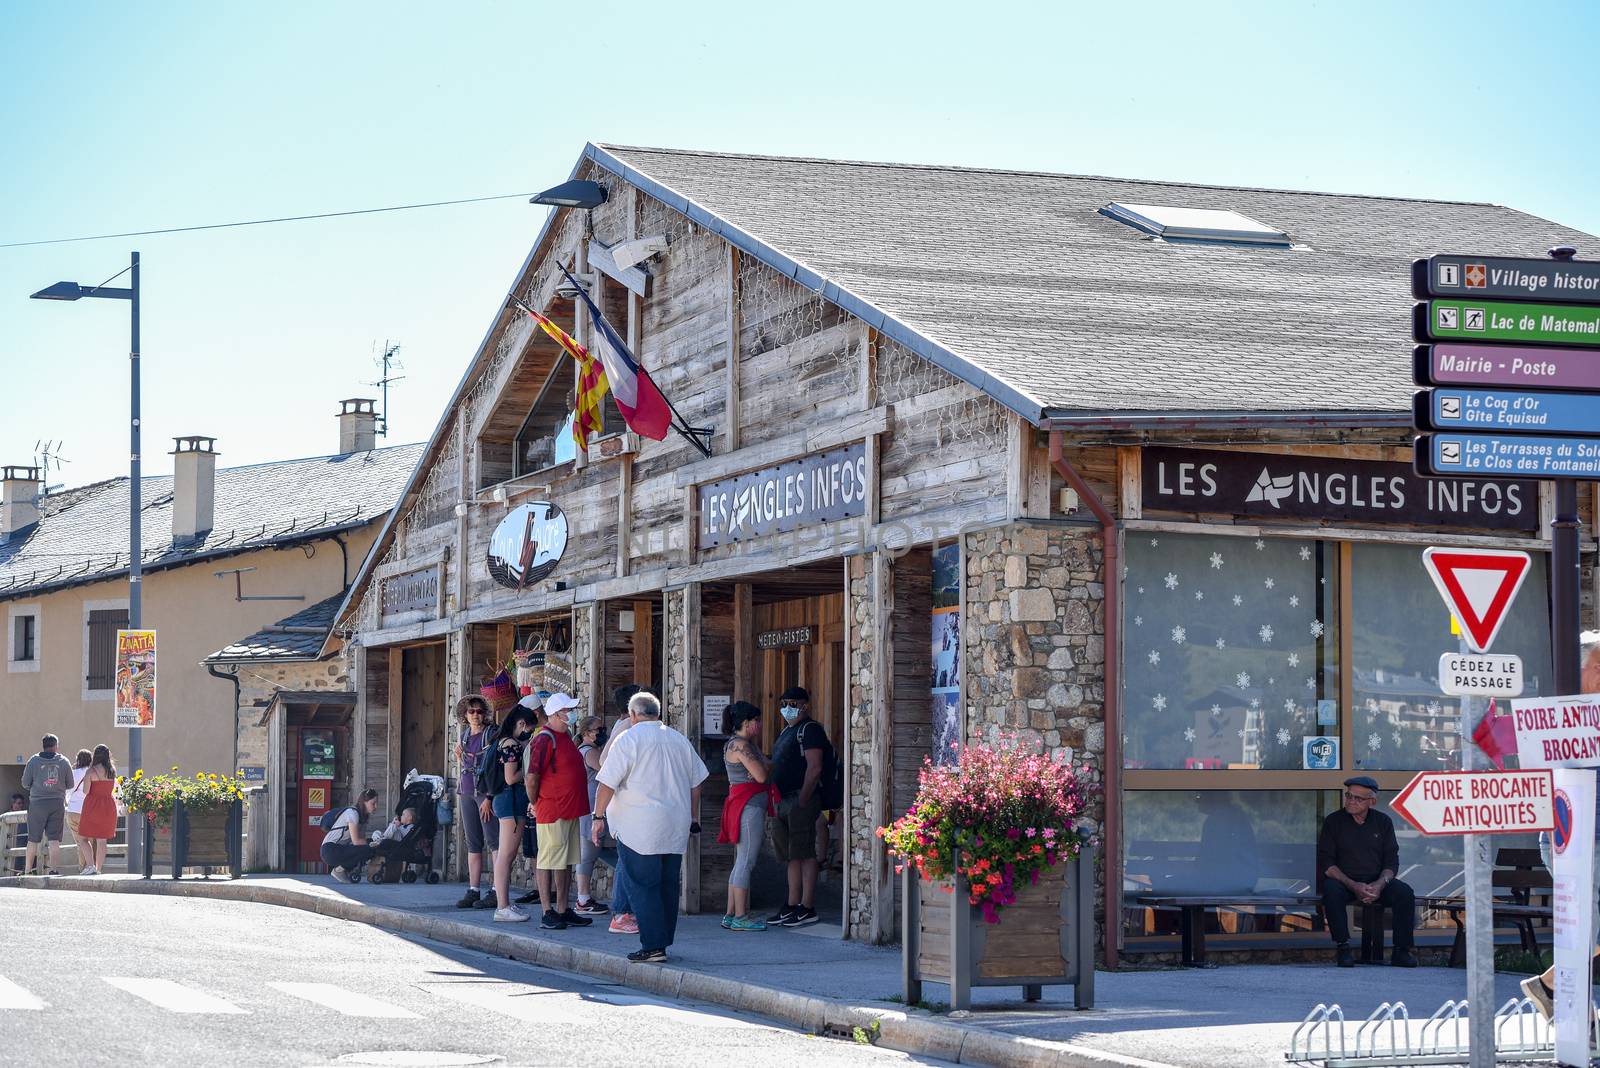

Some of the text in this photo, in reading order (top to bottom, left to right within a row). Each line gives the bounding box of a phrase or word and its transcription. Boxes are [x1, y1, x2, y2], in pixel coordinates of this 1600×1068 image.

[1491, 269, 1547, 291] Village
[1491, 312, 1514, 329] Lac
[1519, 315, 1535, 330] de
[1440, 355, 1492, 373] Mairie
[1512, 358, 1556, 375] Poste
[1466, 395, 1539, 411] Le Coq d'Or
[1498, 411, 1547, 425] Equisud
[1466, 440, 1486, 453] Les
[1492, 440, 1552, 455] Terrasses
[1557, 444, 1572, 457] du
[1466, 454, 1480, 467] Le
[1485, 455, 1513, 468] Clos
[1517, 457, 1539, 470] des
[811, 456, 865, 512] INFOS
[1158, 462, 1217, 497] LES
[1427, 480, 1522, 515] INFOS
[1451, 658, 1516, 673] CÉDEZ LE
[1455, 676, 1512, 689] PASSAGE
[1515, 706, 1558, 731] FOIRE
[1423, 776, 1547, 800] FOIRE BROCANTE
[1442, 802, 1537, 827] ANTIQUITÉS
